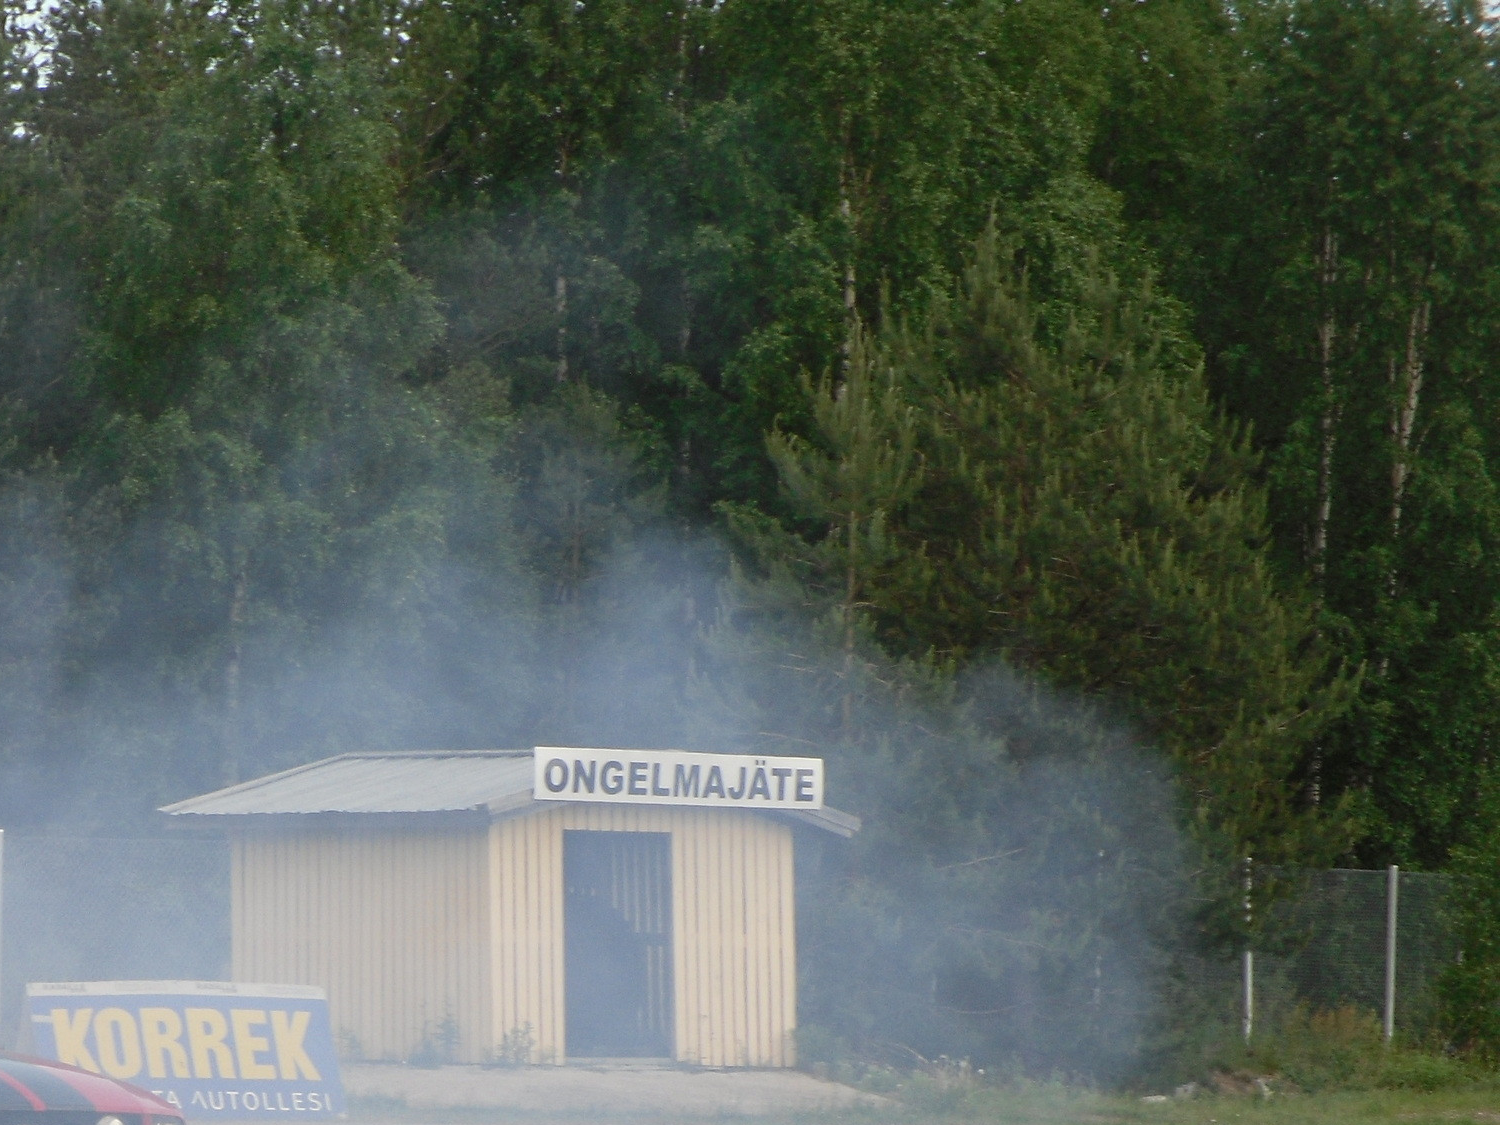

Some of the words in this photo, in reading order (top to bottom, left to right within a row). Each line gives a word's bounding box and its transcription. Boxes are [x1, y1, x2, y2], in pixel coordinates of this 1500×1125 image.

[544, 758, 814, 802] ONGELMAJÄTE
[52, 1007, 322, 1081] KORREK
[191, 1091, 333, 1112] AUTOLLESI
